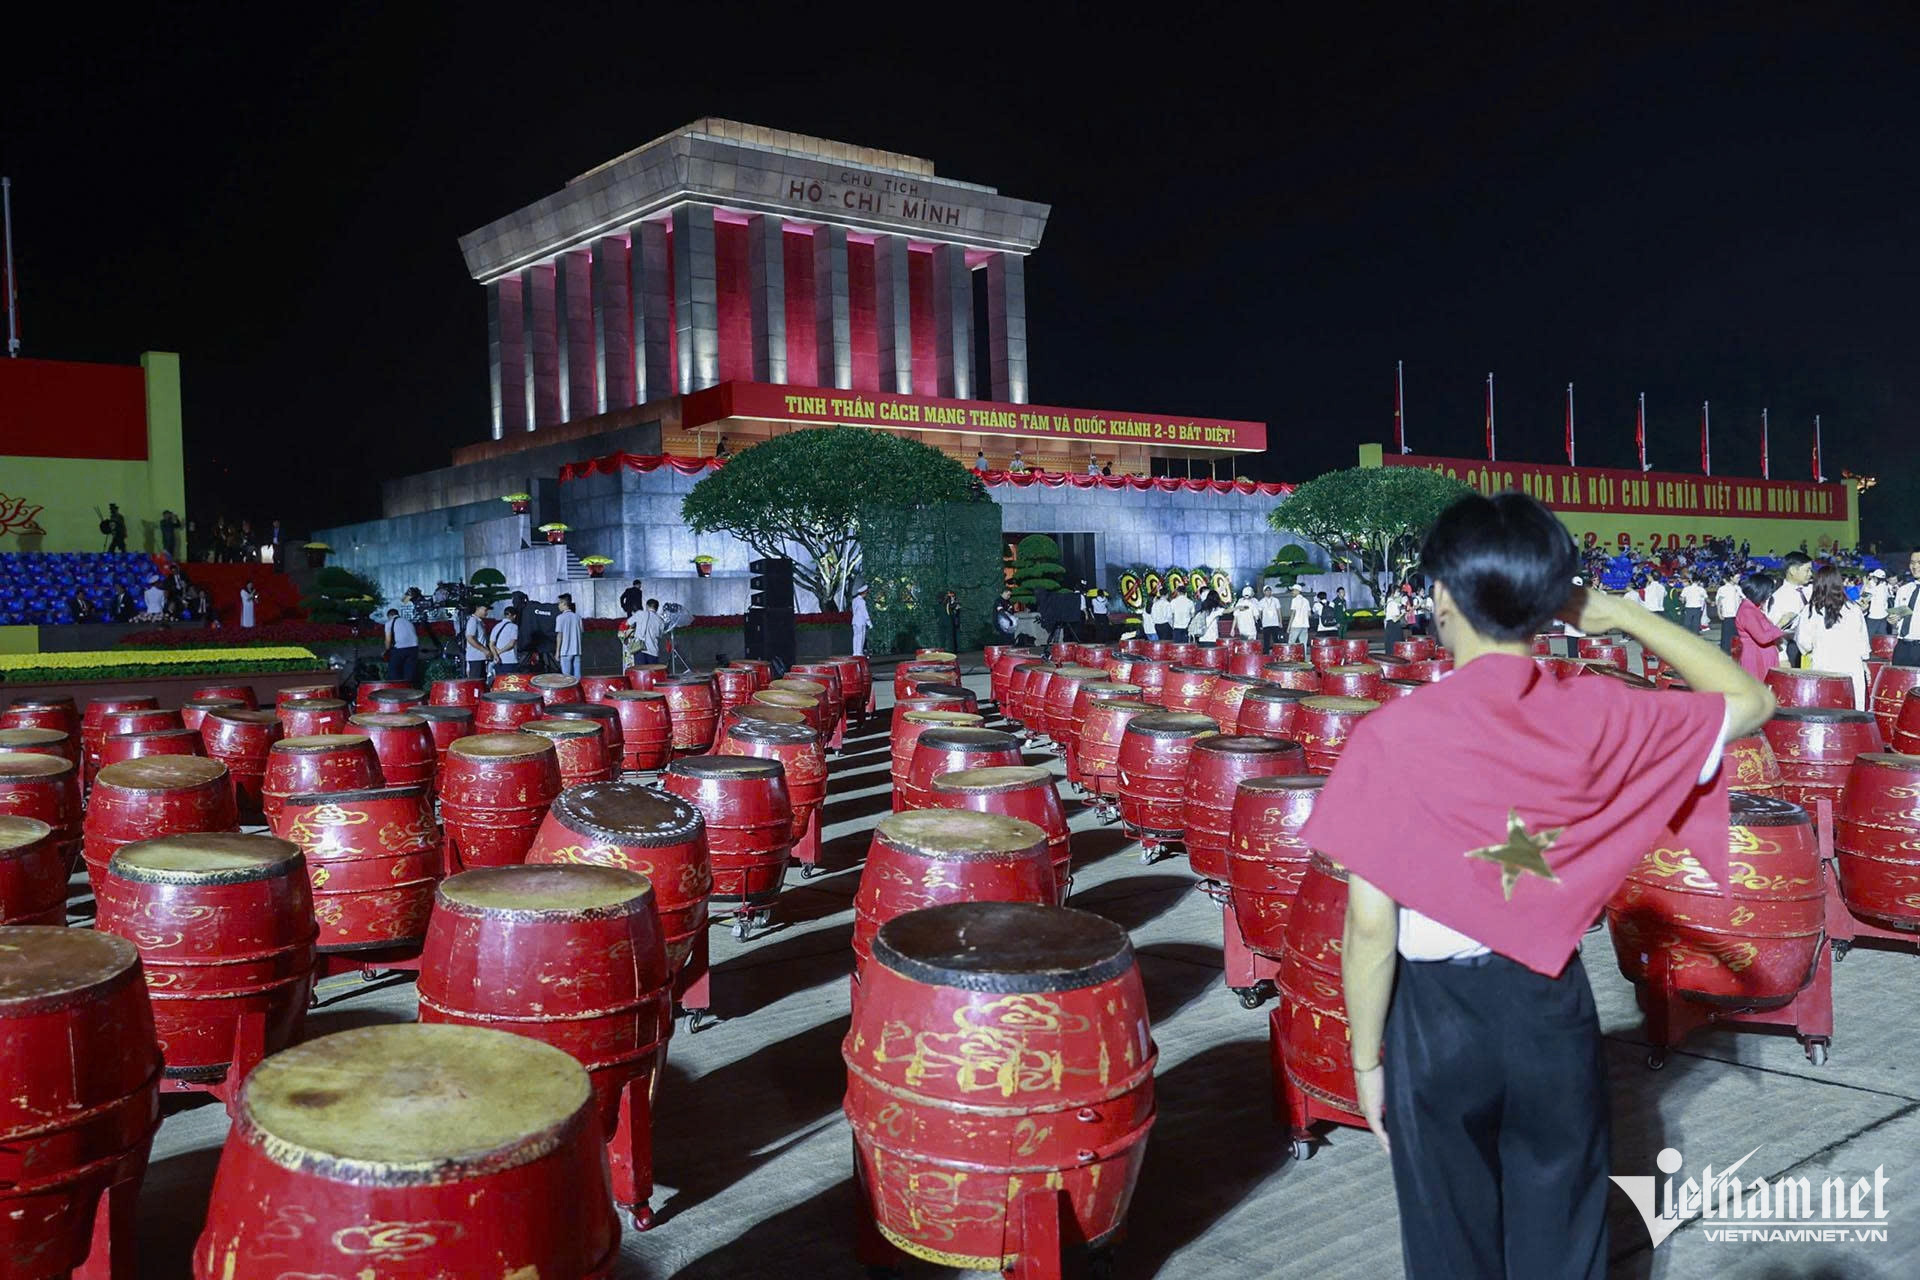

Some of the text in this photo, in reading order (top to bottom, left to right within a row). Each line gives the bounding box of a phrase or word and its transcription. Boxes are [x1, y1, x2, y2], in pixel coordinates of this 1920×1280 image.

[784, 395, 828, 416] TINH
[880, 401, 920, 422] CÁCH
[924, 406, 966, 427] MẠNG
[969, 408, 1017, 429] THÁNG
[1020, 411, 1050, 431] TÁM
[1154, 423, 1177, 440] 2-9
